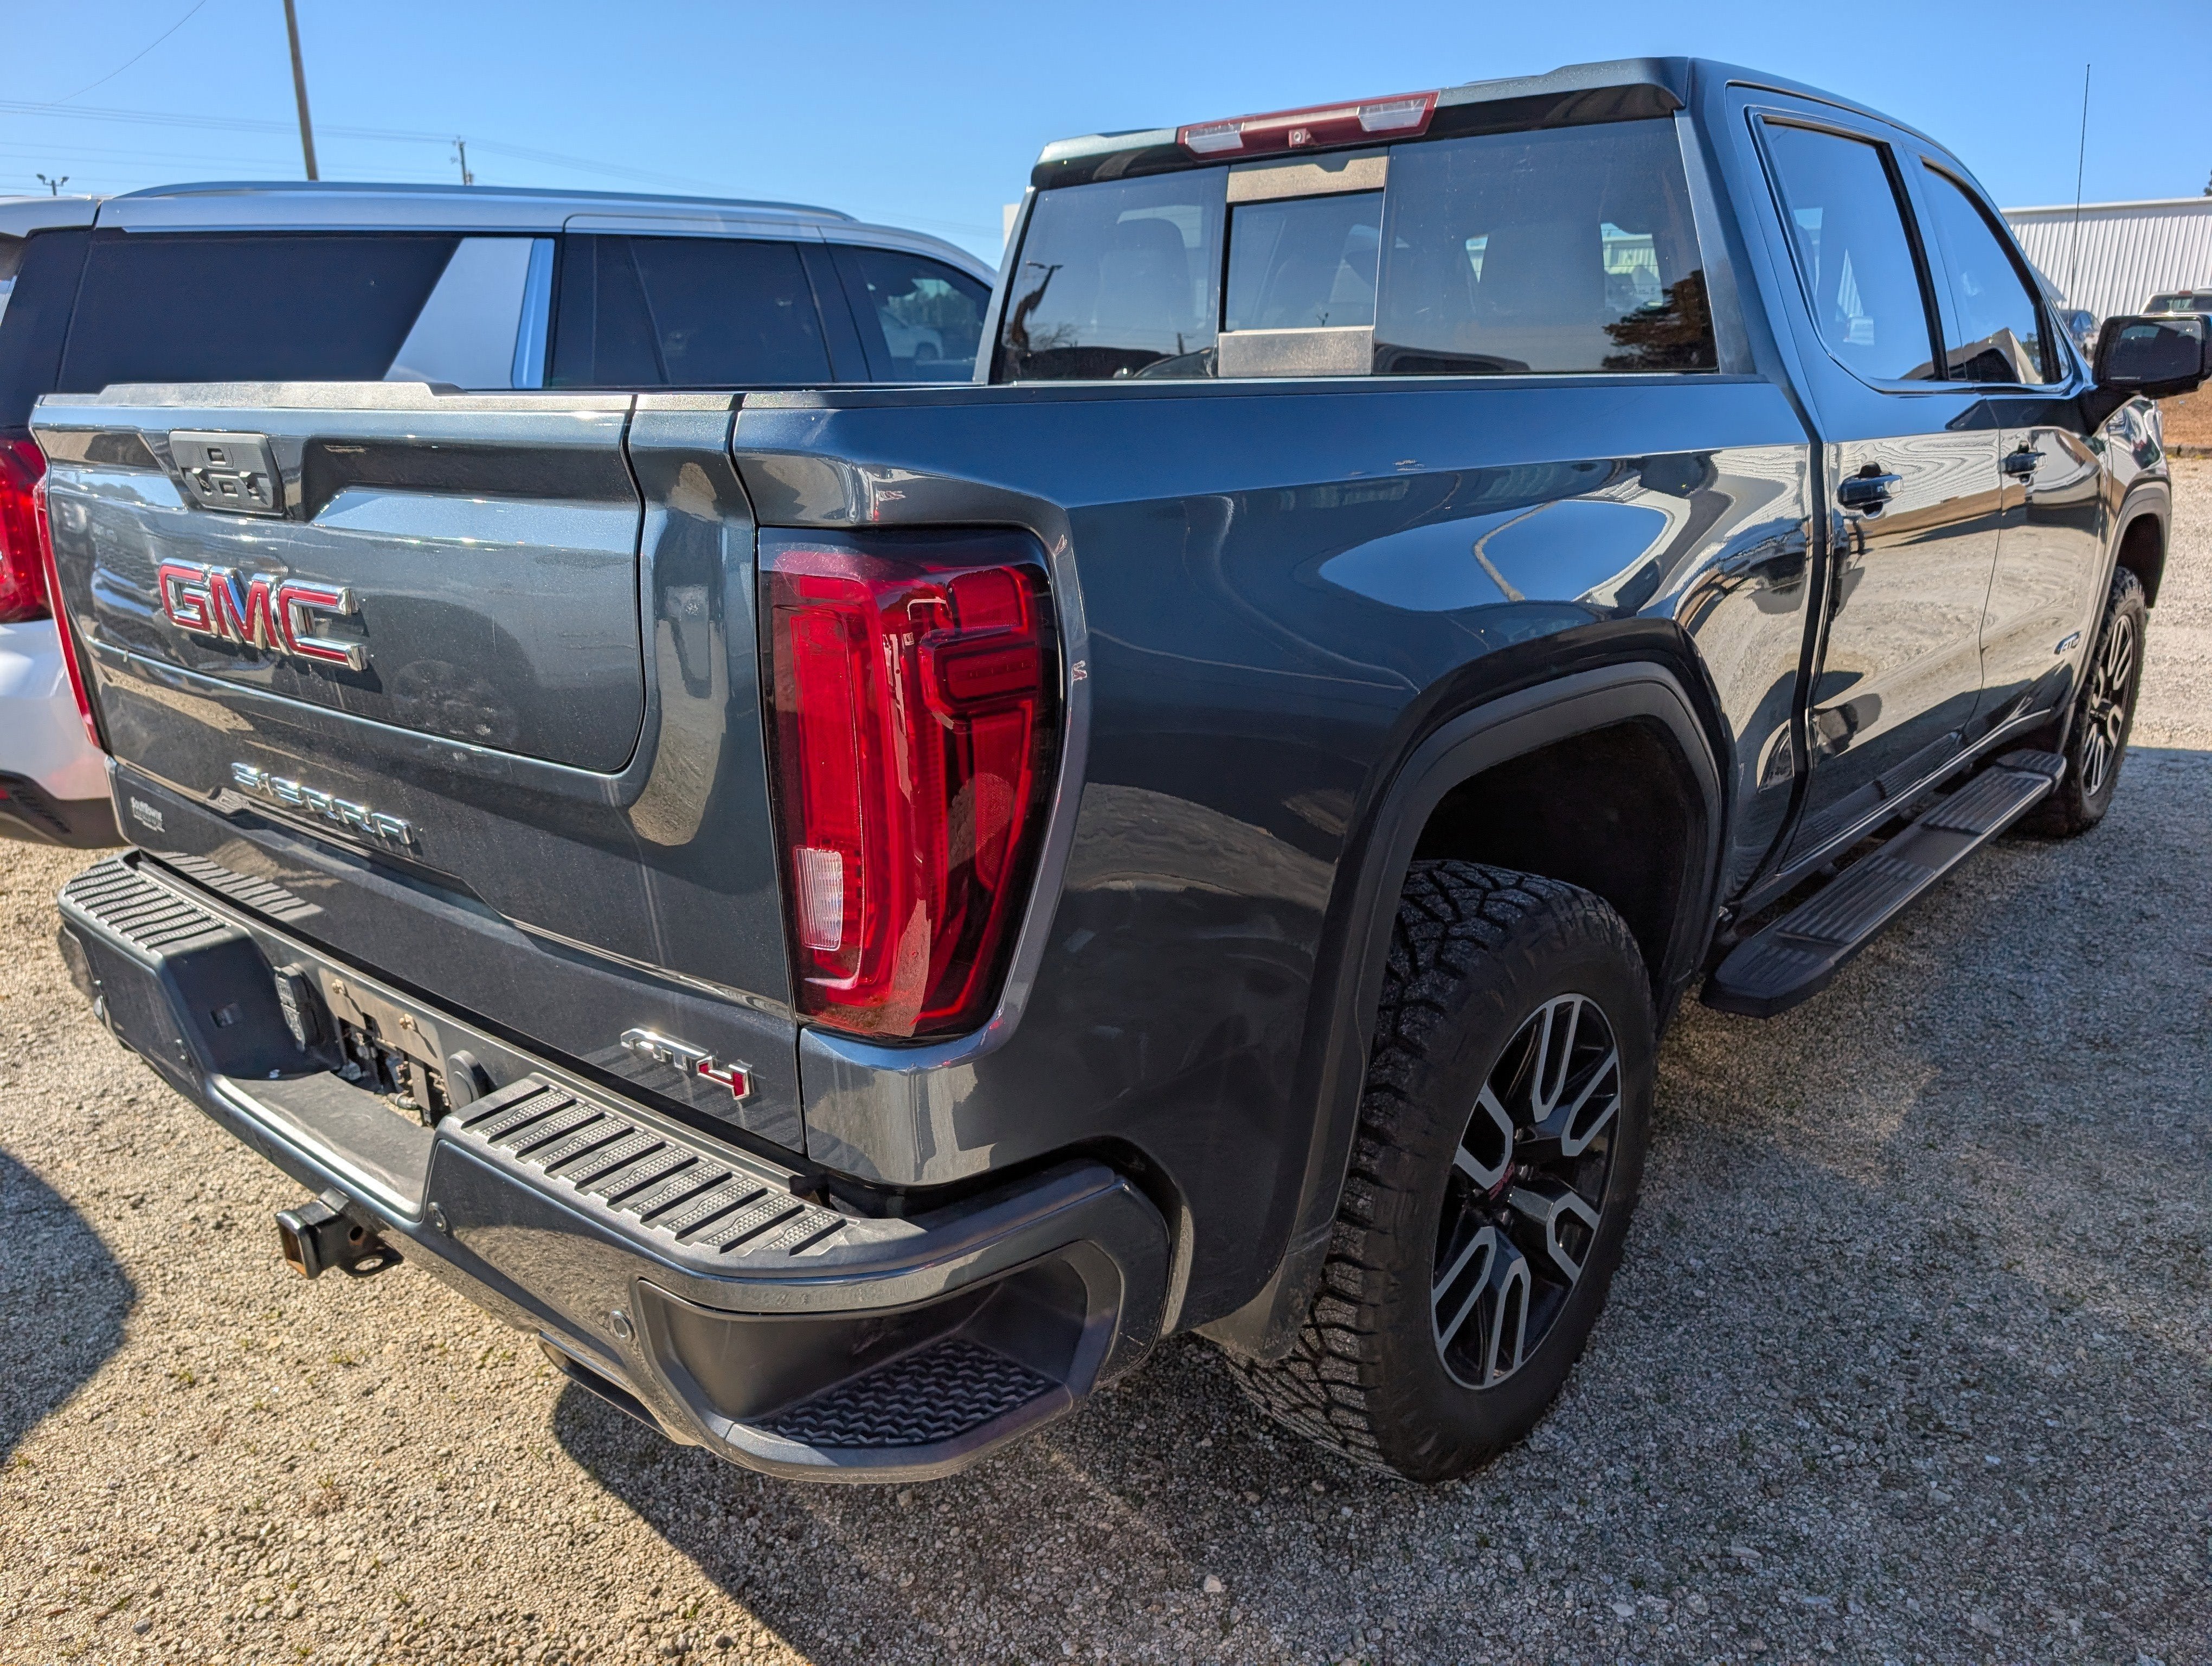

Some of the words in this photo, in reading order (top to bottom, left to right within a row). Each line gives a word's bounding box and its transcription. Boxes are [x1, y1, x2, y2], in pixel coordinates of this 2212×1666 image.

[159, 558, 366, 671] GMC
[232, 762, 414, 844] SIERRA
[621, 1028, 752, 1100] AT4
